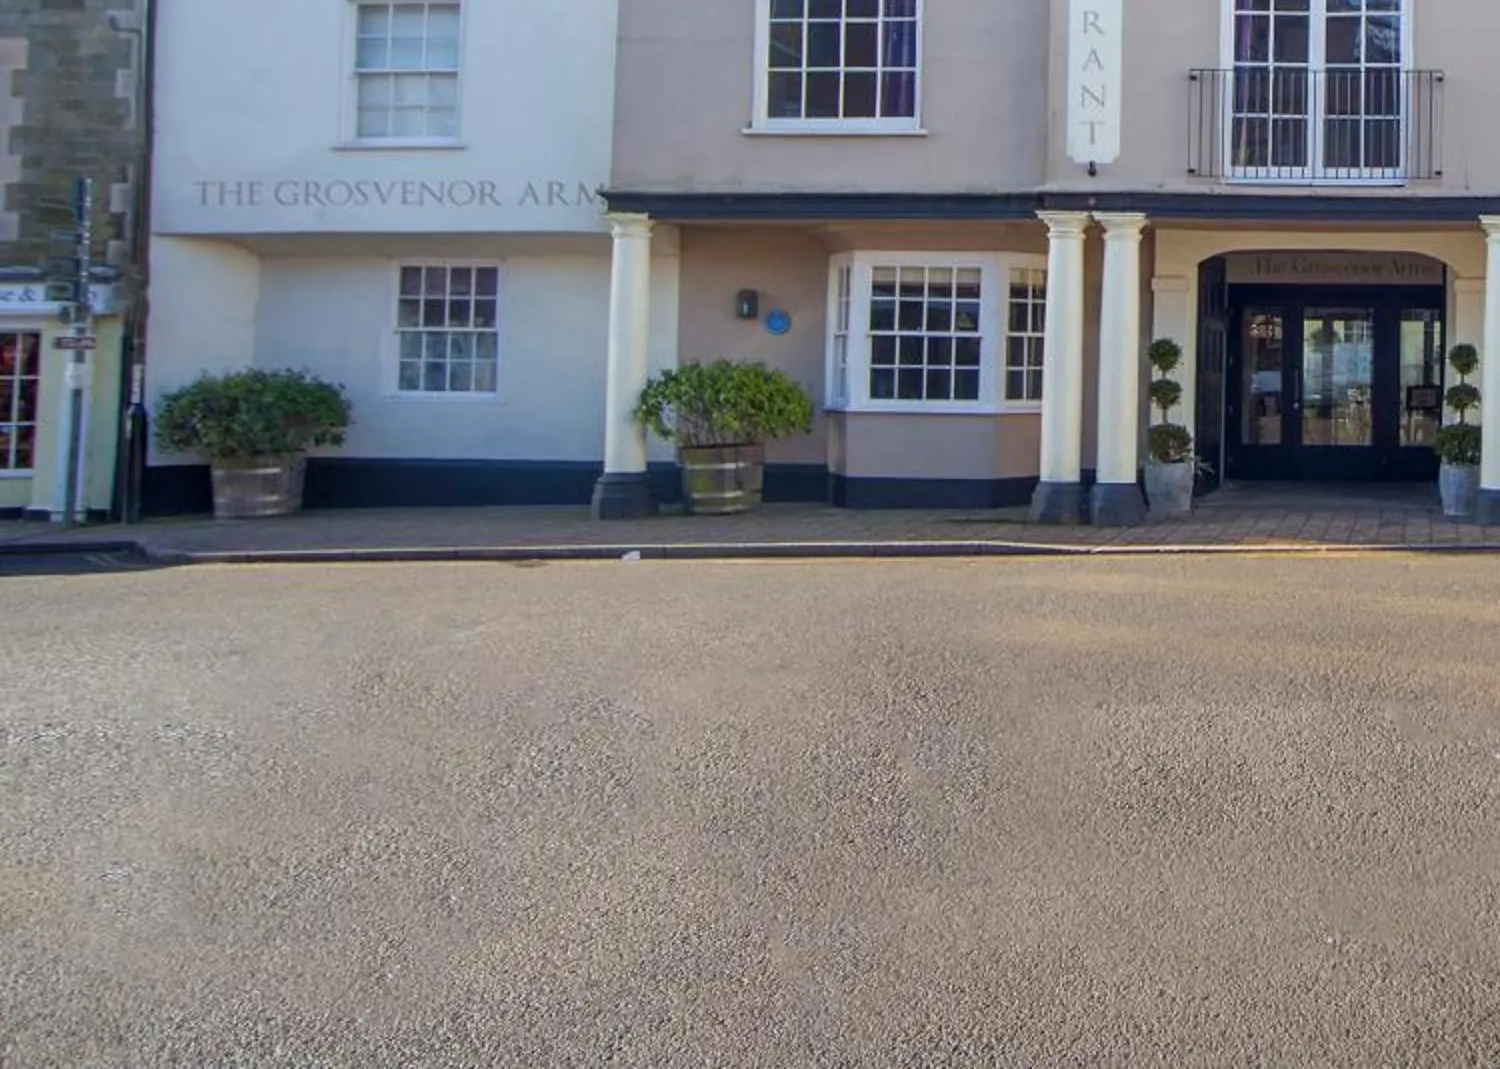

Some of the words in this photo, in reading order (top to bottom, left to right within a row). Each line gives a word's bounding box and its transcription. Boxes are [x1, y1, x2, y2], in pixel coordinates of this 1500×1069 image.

[192, 179, 264, 207] THE
[273, 179, 501, 208] GROSVENOR
[518, 179, 607, 207] ARM
